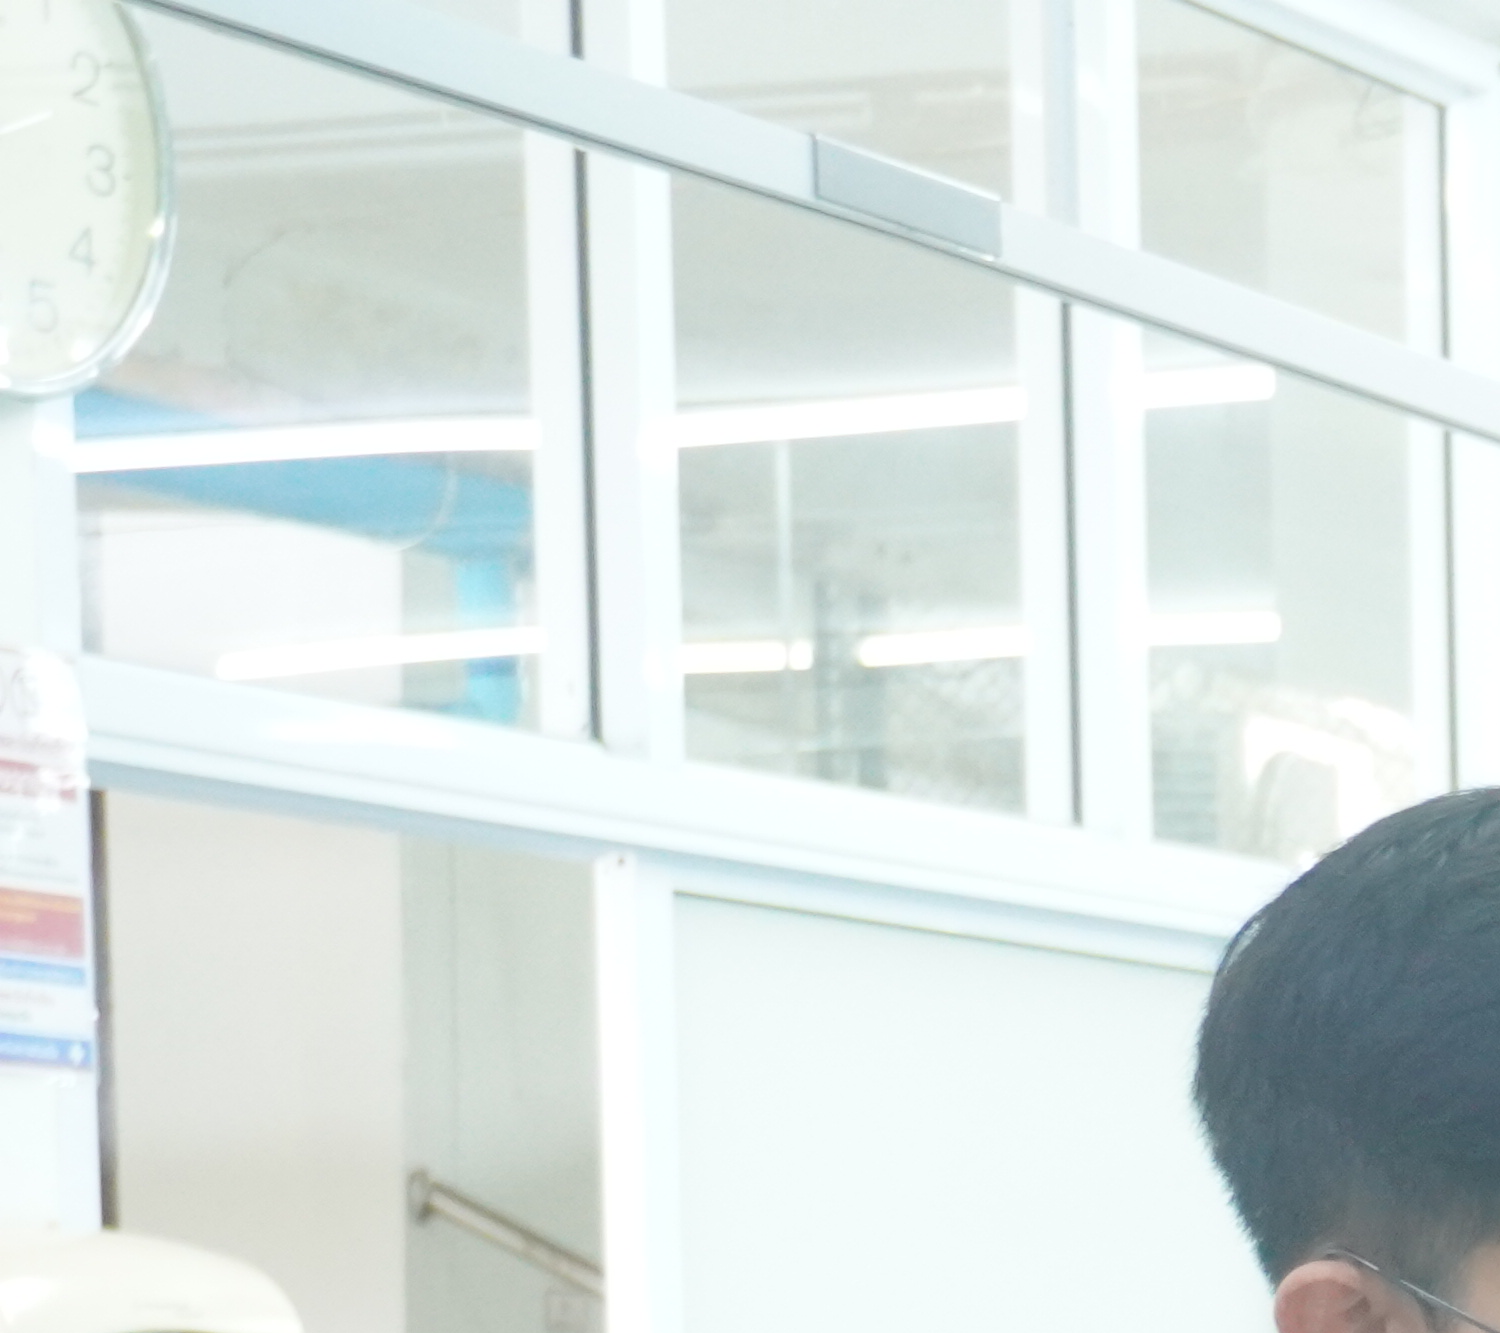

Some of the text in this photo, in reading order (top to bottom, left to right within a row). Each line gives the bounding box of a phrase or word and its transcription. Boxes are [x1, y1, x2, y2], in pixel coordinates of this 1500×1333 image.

[69, 49, 101, 107] 2
[85, 143, 117, 198] 3
[67, 225, 97, 276] 4
[27, 277, 60, 334] 5
